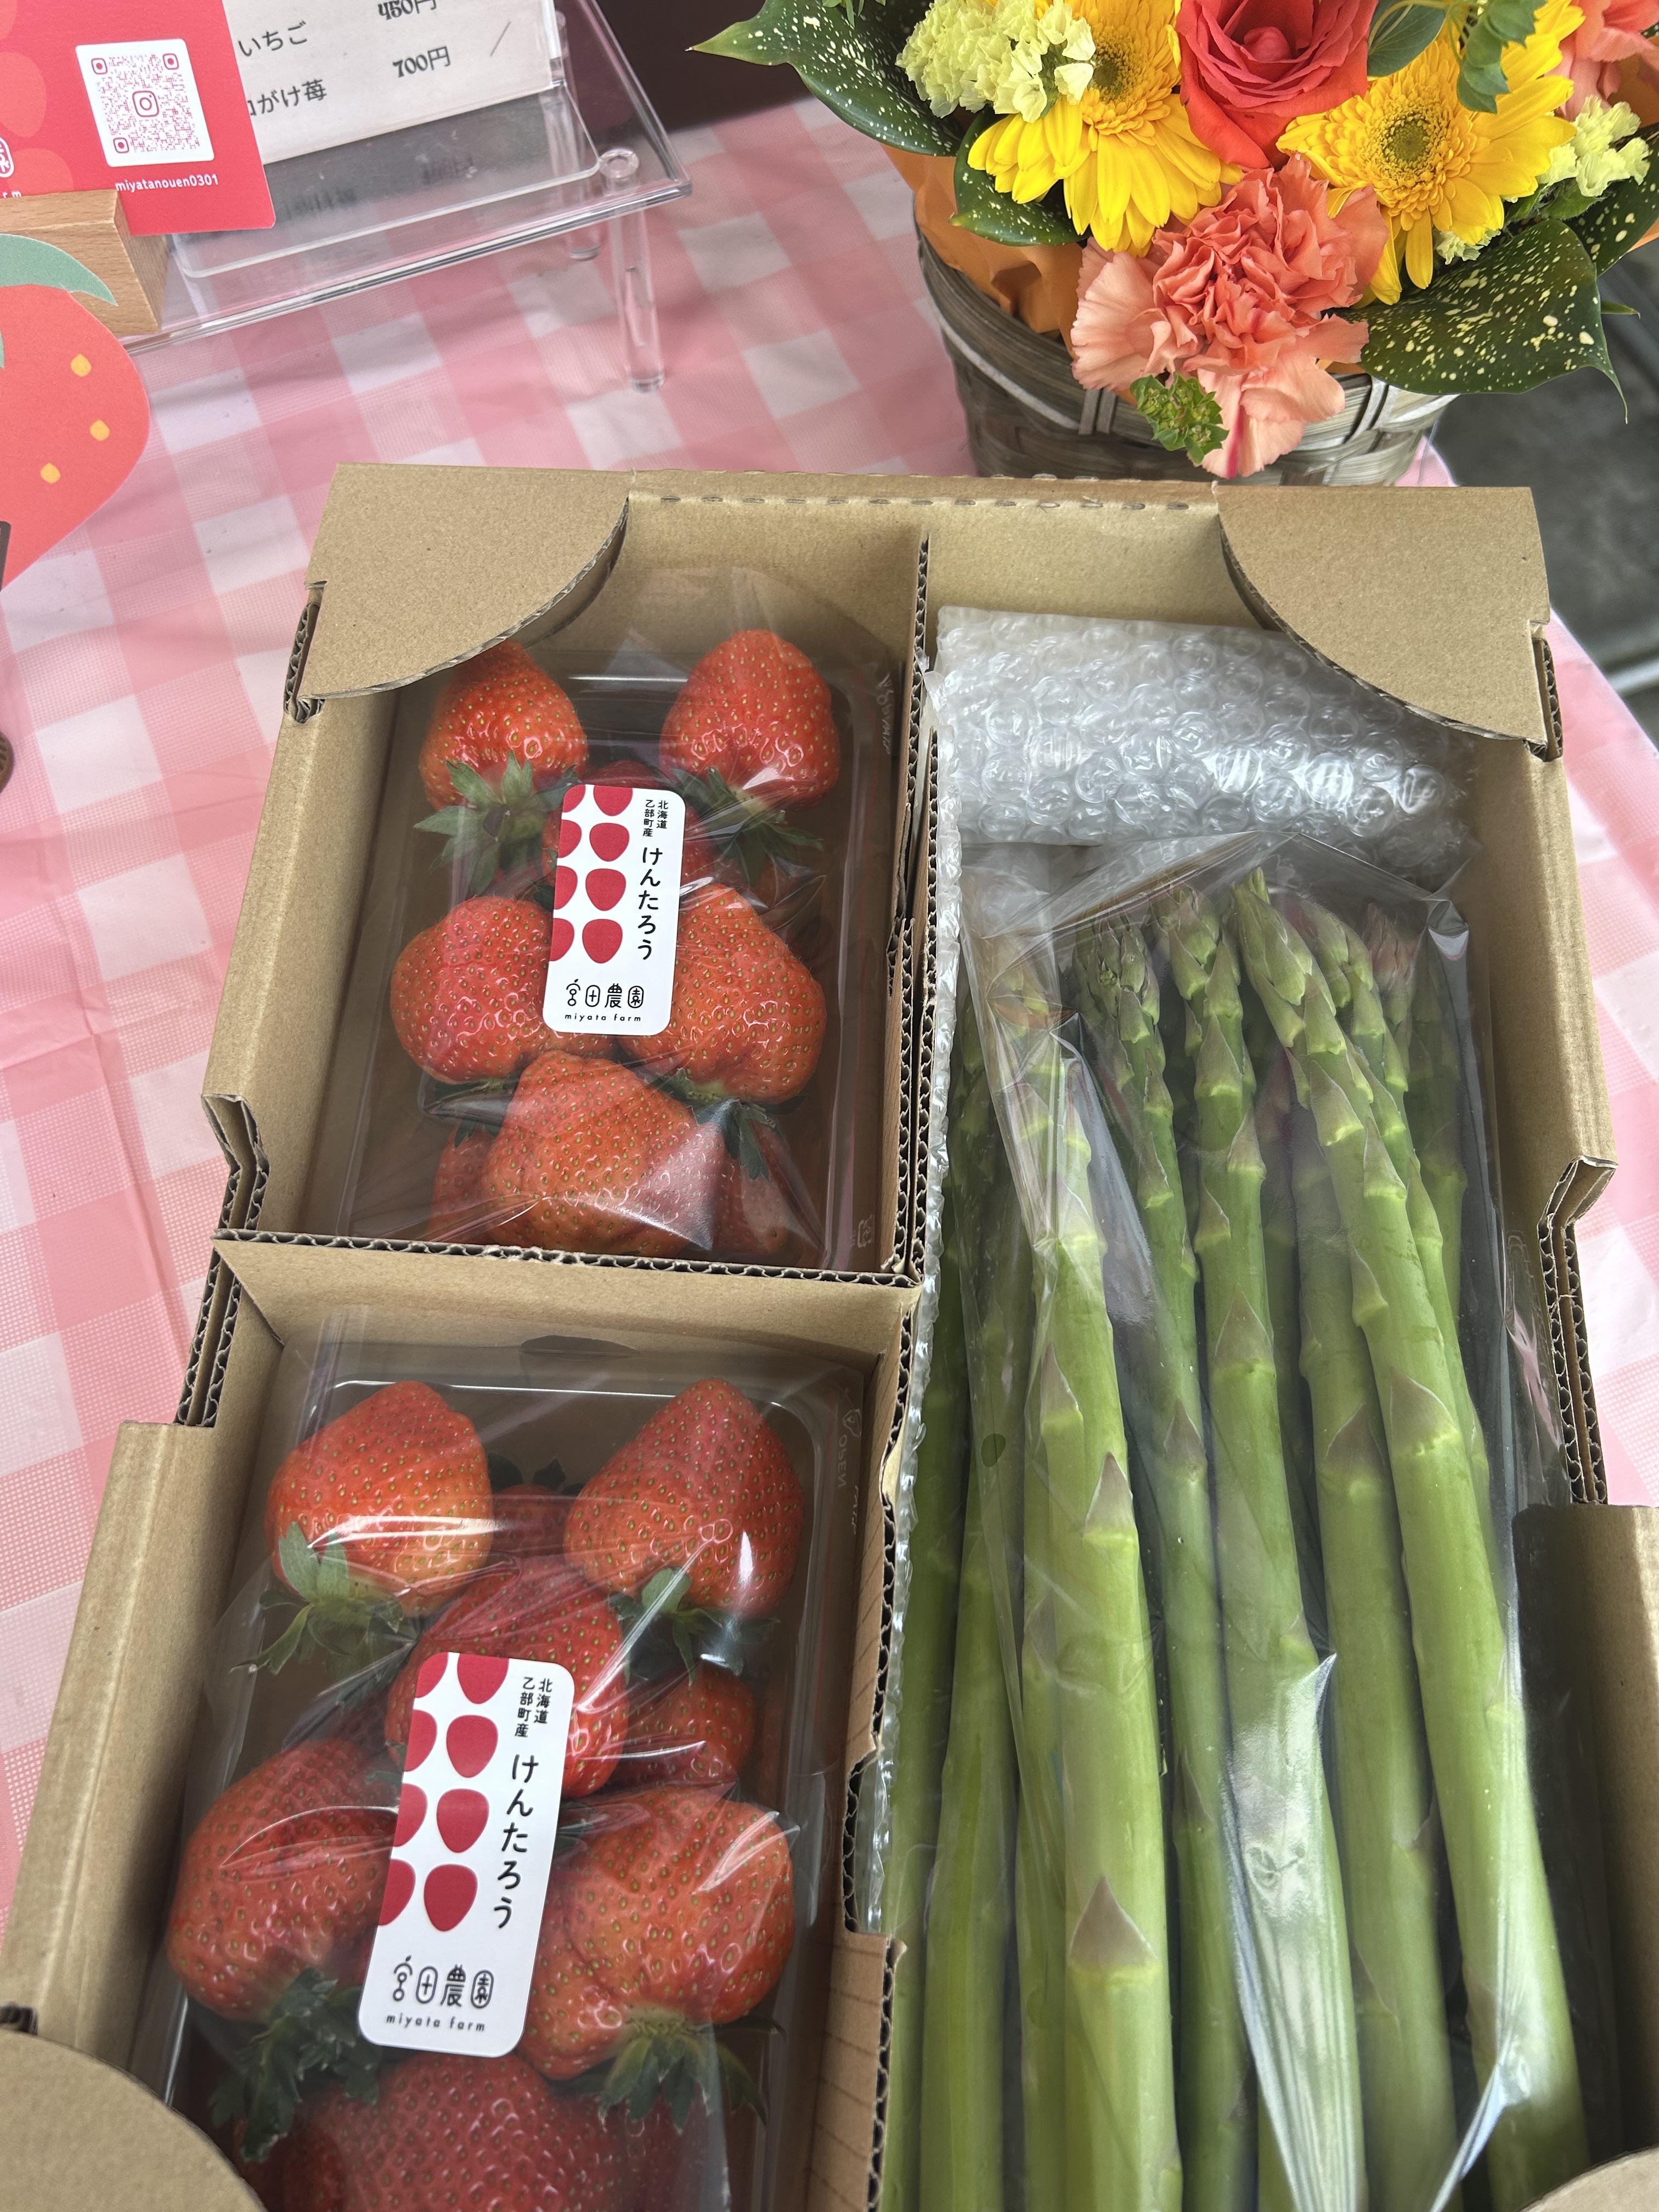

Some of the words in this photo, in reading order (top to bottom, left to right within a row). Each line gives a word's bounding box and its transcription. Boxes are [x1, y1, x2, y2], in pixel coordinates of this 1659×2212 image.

[238, 20, 307, 57] いちご
[392, 46, 450, 77] 700円
[115, 174, 218, 193] miyatanouen0301
[642, 799, 655, 837] 乙部町産
[657, 800, 669, 829] 北海道
[637, 847, 663, 960] けんたろう
[566, 978, 644, 1009] 宮田農園
[565, 1013, 607, 1022] miyata
[614, 1013, 641, 1022] farm
[515, 1677, 535, 1737] 乙部町産
[534, 1678, 552, 1724] 北海道
[493, 1754, 539, 1928] けんたろう
[392, 1955, 494, 2009] 宮田農園
[385, 2012, 441, 2029] miyata
[449, 2016, 486, 2032] farm
